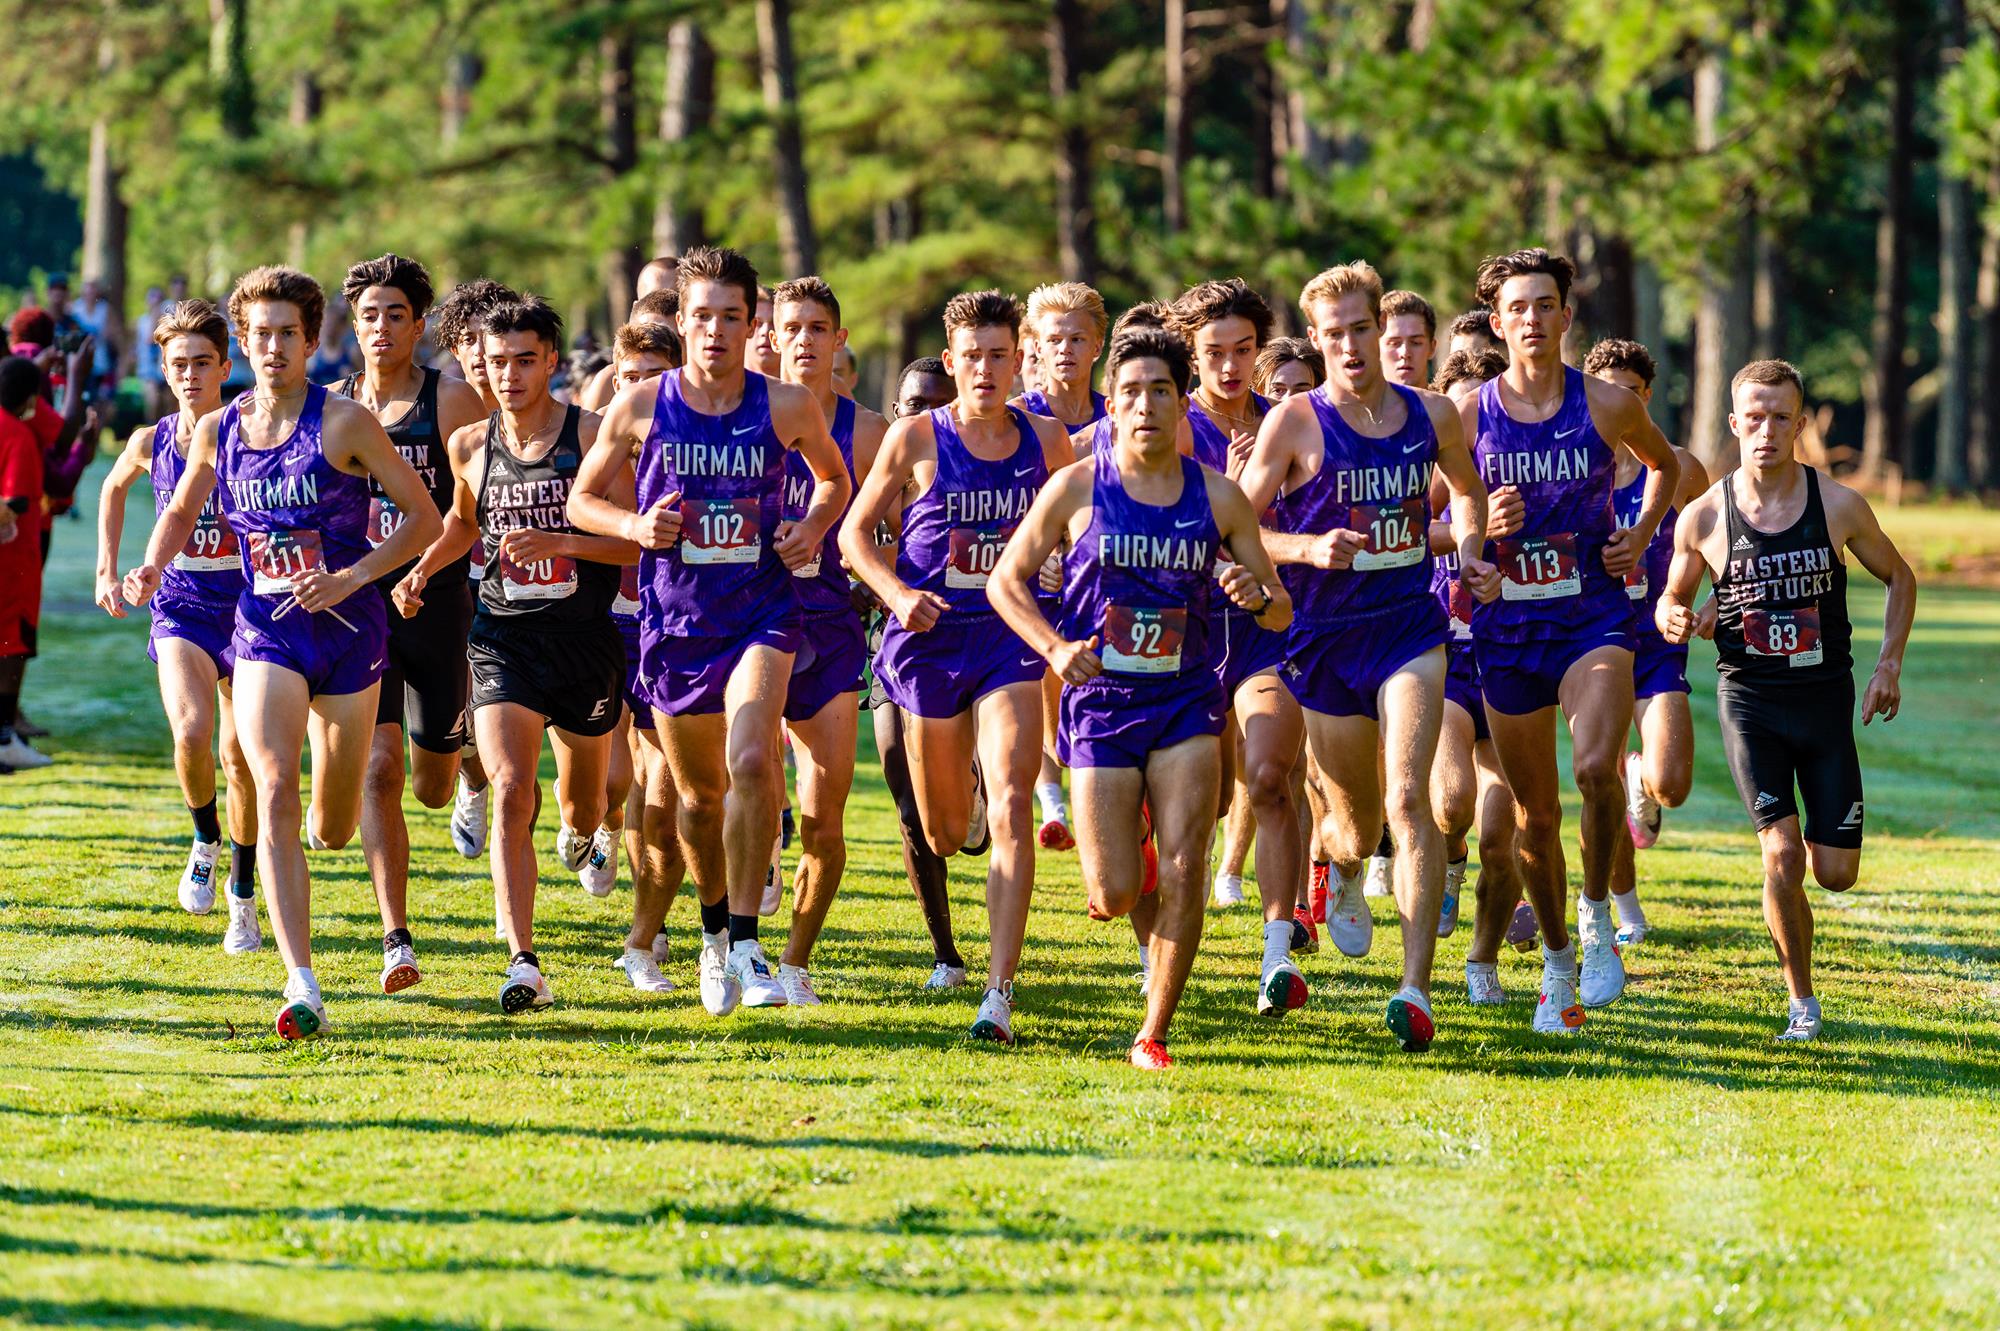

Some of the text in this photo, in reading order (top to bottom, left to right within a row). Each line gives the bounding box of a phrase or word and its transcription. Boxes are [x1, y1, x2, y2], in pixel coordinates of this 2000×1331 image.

[662, 443, 765, 478] FURMAN
[1485, 447, 1589, 484] FURMAN
[226, 473, 318, 512] FURMAN
[1336, 461, 1433, 503] FURMAN
[487, 505, 574, 534] KENTUC
[946, 487, 1042, 522] FURMA
[194, 528, 221, 555] 99
[700, 513, 744, 545] 102
[1370, 516, 1412, 550] 104
[264, 544, 307, 576] 111
[1099, 534, 1207, 571] FURMAN
[1732, 543, 1754, 551] adidas
[1516, 549, 1561, 581] 113
[1730, 547, 1831, 583] EASTERN
[1131, 623, 1162, 654] 92
[1768, 623, 1798, 651] 83
[1754, 796, 1779, 811] adidas
